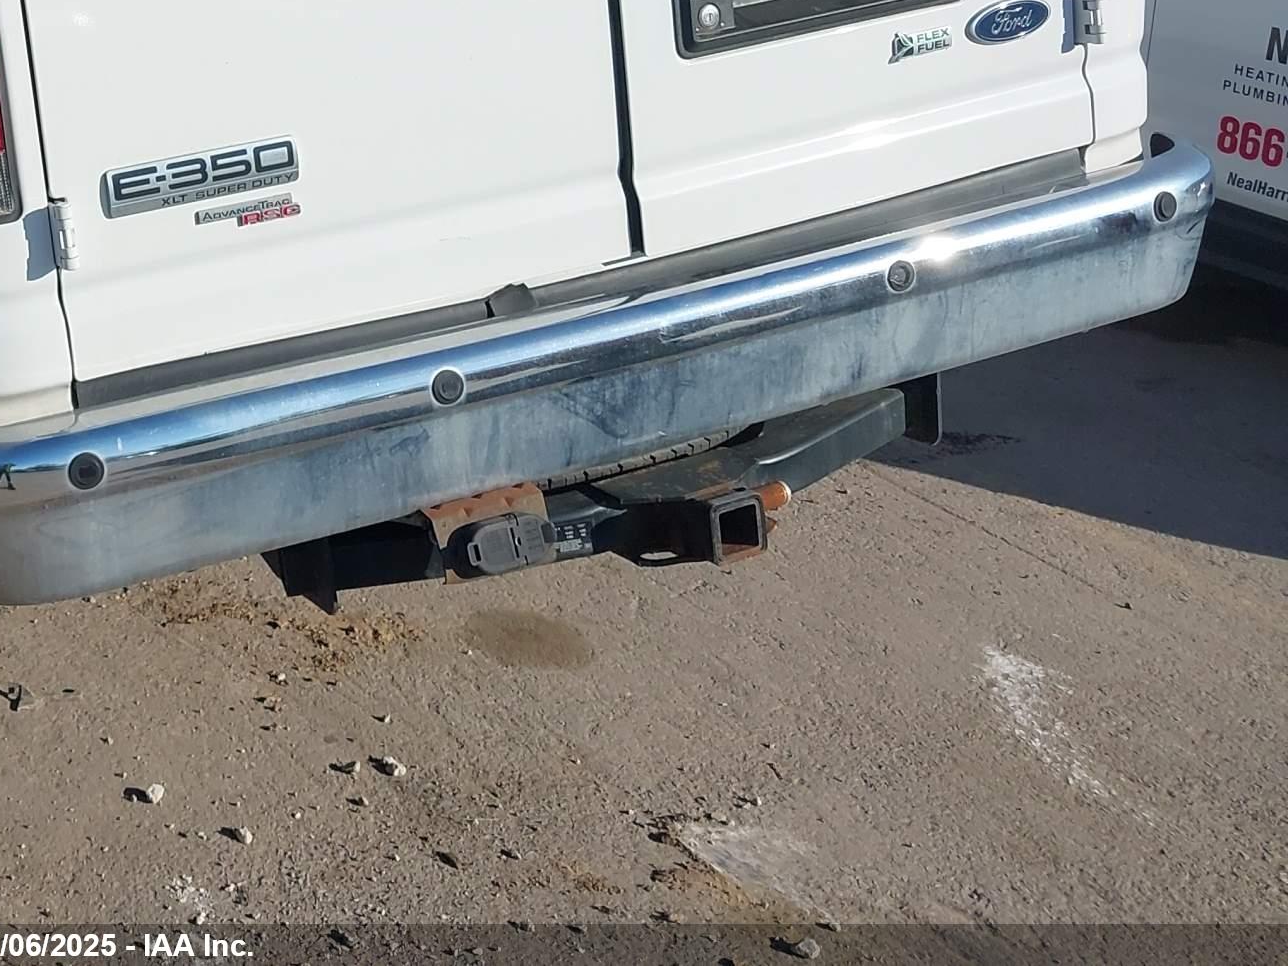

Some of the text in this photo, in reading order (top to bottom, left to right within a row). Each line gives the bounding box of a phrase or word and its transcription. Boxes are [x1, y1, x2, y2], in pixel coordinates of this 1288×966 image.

[991, 5, 1033, 35] Ford
[916, 28, 950, 43] FLEX
[917, 38, 951, 54] FUEL
[111, 139, 295, 202] E-350
[161, 173, 293, 207] XLT SUPER DUTY
